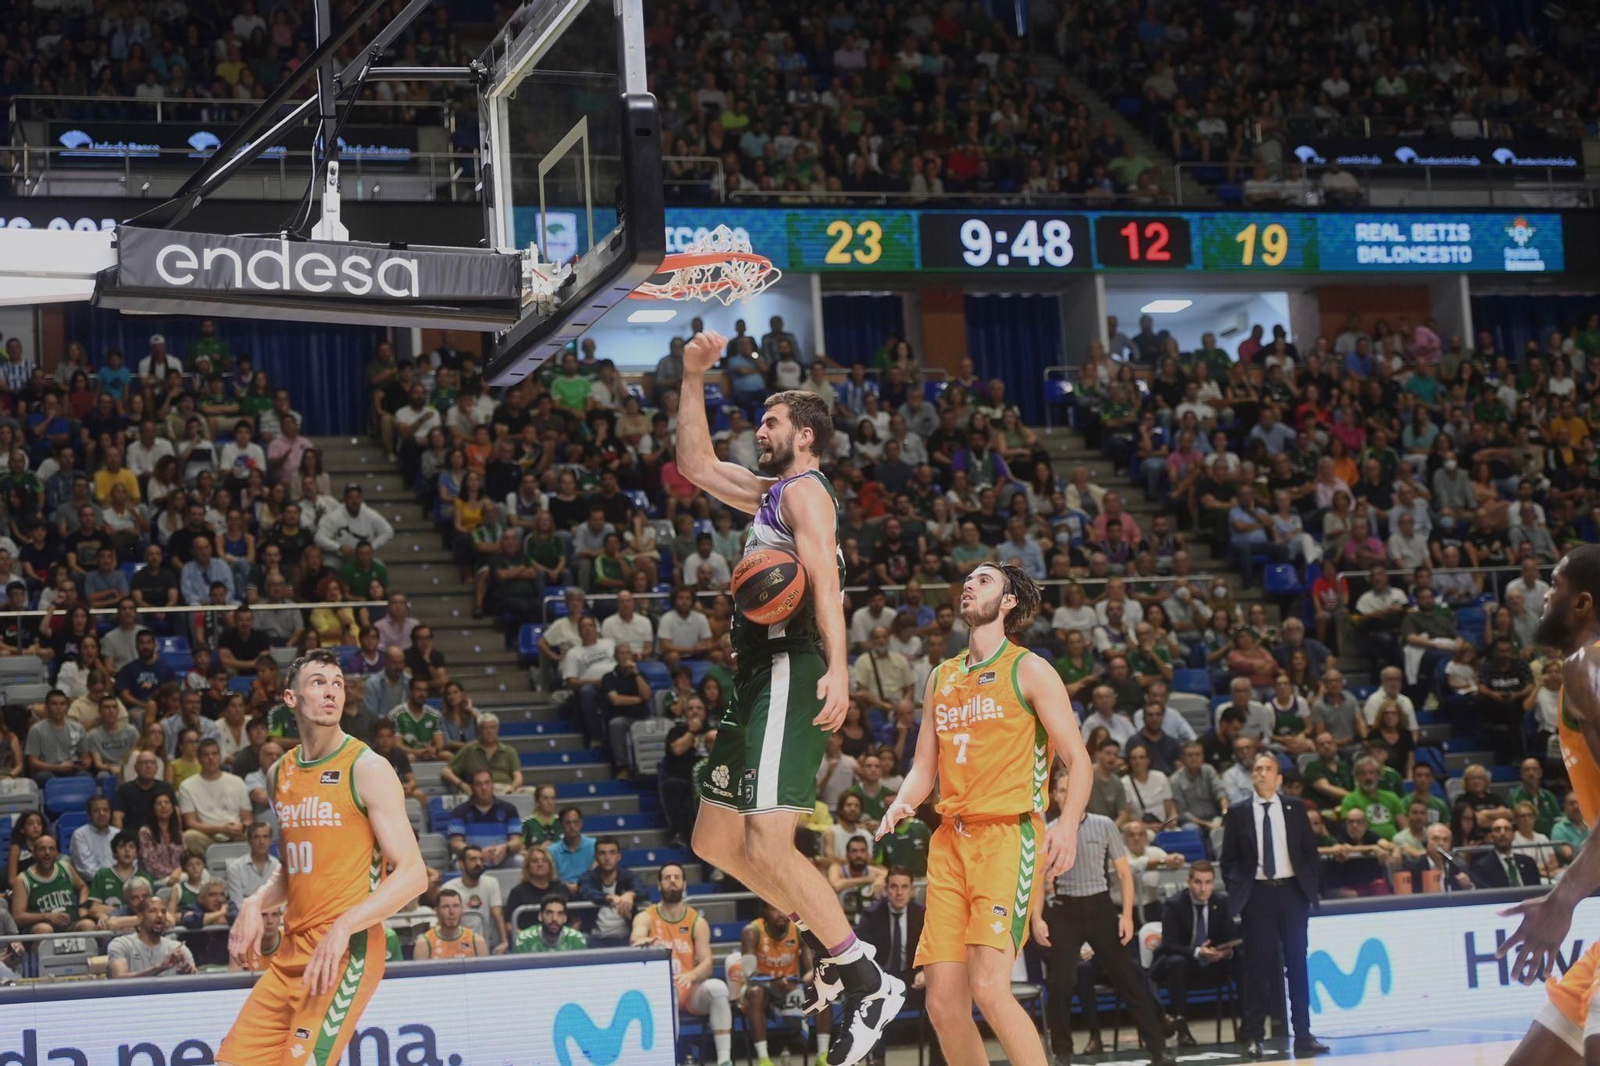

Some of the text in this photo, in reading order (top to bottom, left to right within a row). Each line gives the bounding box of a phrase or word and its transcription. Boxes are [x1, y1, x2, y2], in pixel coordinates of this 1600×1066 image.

[823, 219, 884, 265] 23
[960, 218, 1074, 267] 9:48
[1120, 221, 1171, 262] 12
[1235, 222, 1289, 267] 19
[1355, 223, 1471, 242] REAL BETIS
[156, 230, 419, 298] endesa
[1357, 245, 1473, 264] BALONCESTO
[953, 733, 971, 764] 7
[286, 841, 313, 876] 00
[37, 889, 73, 914] CELTICS
